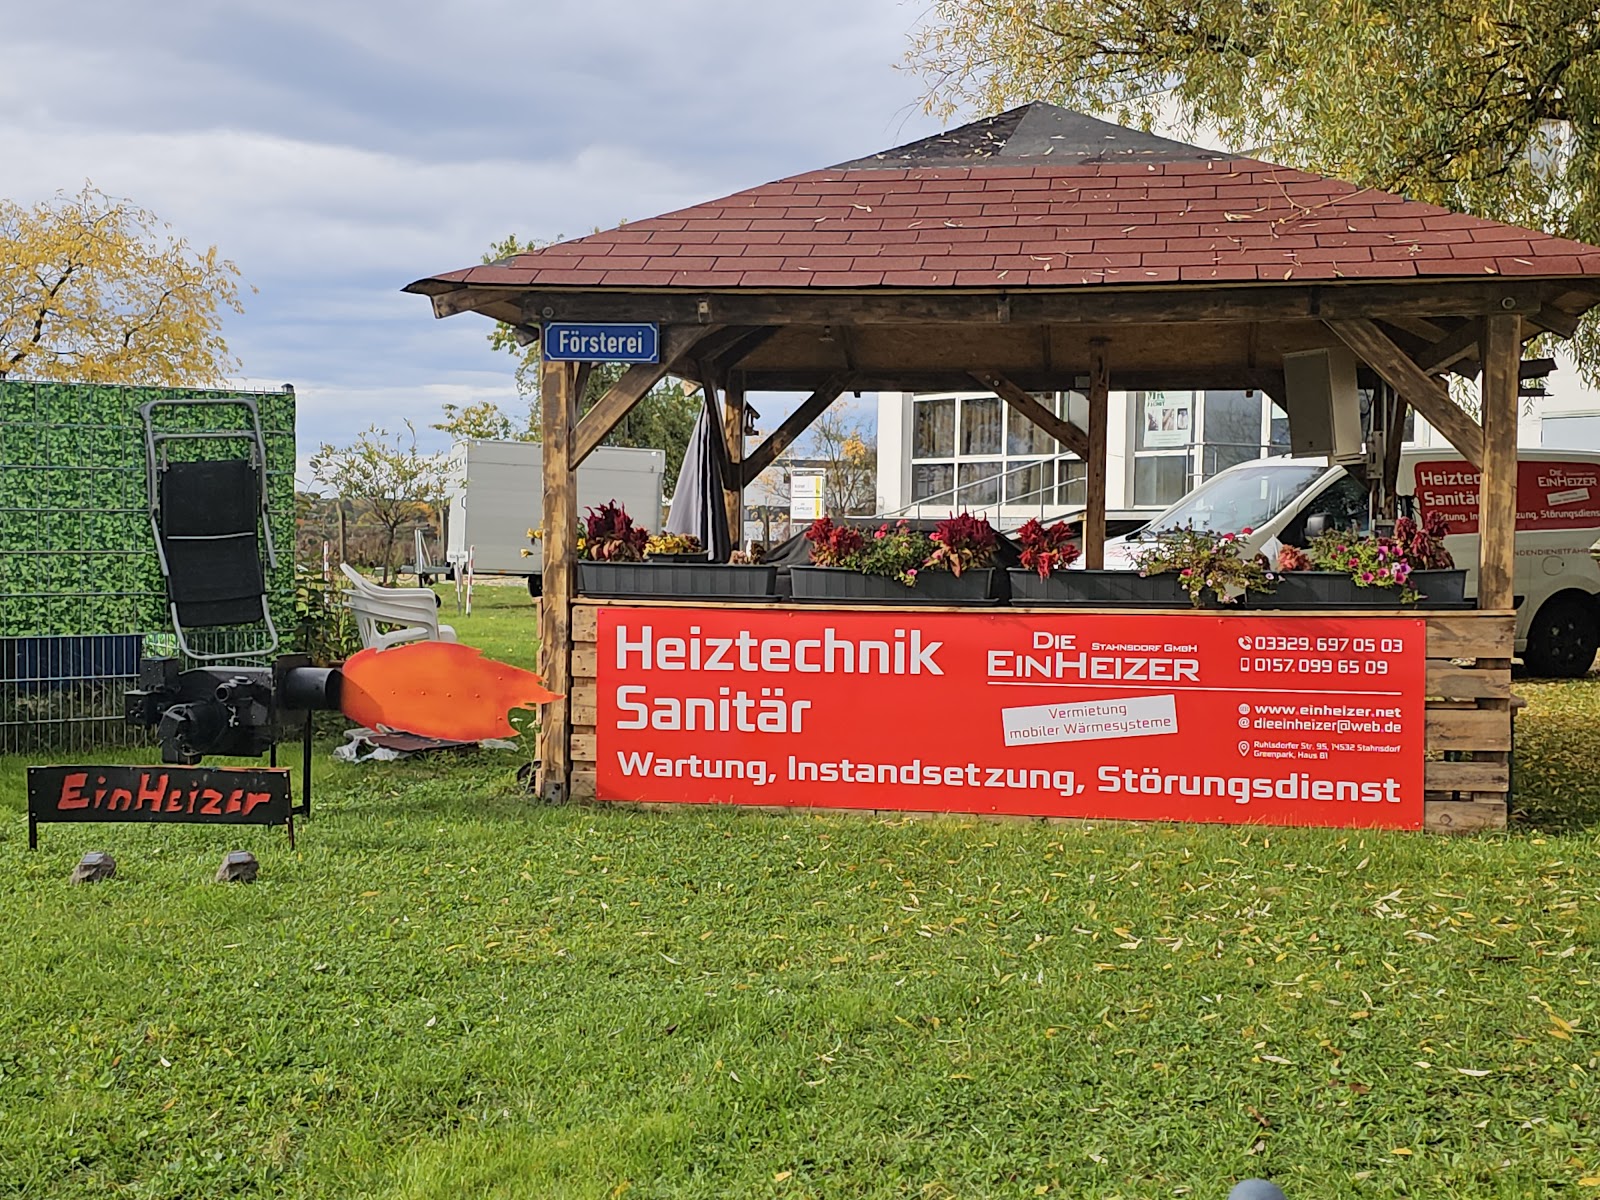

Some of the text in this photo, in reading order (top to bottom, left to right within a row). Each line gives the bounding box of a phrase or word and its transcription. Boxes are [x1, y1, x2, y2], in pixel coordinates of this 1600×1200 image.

[559, 330, 643, 354] Försterei
[1421, 470, 1481, 486] Heiztec
[1033, 631, 1076, 650] DIE
[1353, 638, 1375, 653] 05
[1381, 638, 1402, 653] 03
[616, 625, 945, 675] Heiztechnik
[1338, 660, 1360, 674] 65
[1365, 660, 1388, 675] 09
[616, 685, 812, 733] Sanitär
[1048, 705, 1127, 719] Vermietung
[1254, 704, 1402, 718] www.einheizer.net
[1009, 718, 1171, 739] mobiler Wärmesysteme
[1253, 717, 1402, 734] dieeinheizer@web.de
[1253, 740, 1300, 750] Ruhlsdorfer
[1301, 742, 1315, 750] Str.
[1356, 744, 1402, 754] Stahnsdorf
[1298, 751, 1318, 760] Haus
[616, 751, 1401, 804] Wartung, Instandsetzung, Störungsdienst
[57, 772, 271, 816] EinHeizer
